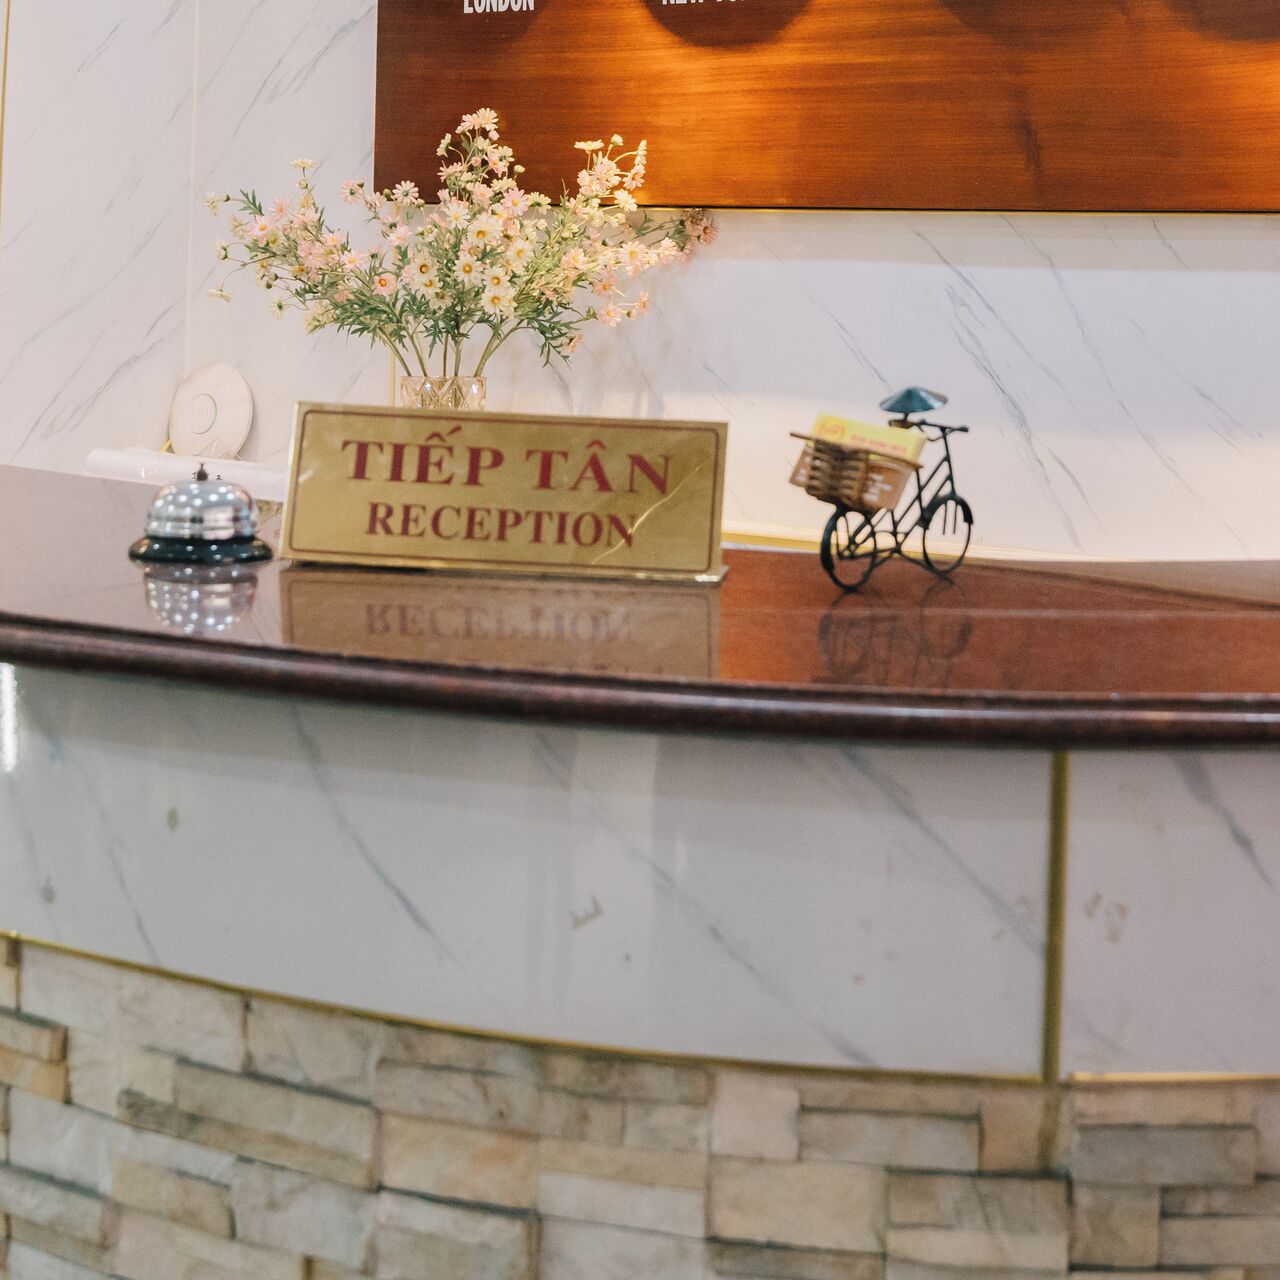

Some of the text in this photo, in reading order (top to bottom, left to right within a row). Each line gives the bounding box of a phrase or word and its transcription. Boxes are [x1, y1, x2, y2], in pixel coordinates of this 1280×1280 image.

[341, 425, 672, 496] TIẾP TÂN
[366, 501, 637, 548] RECEPTION
